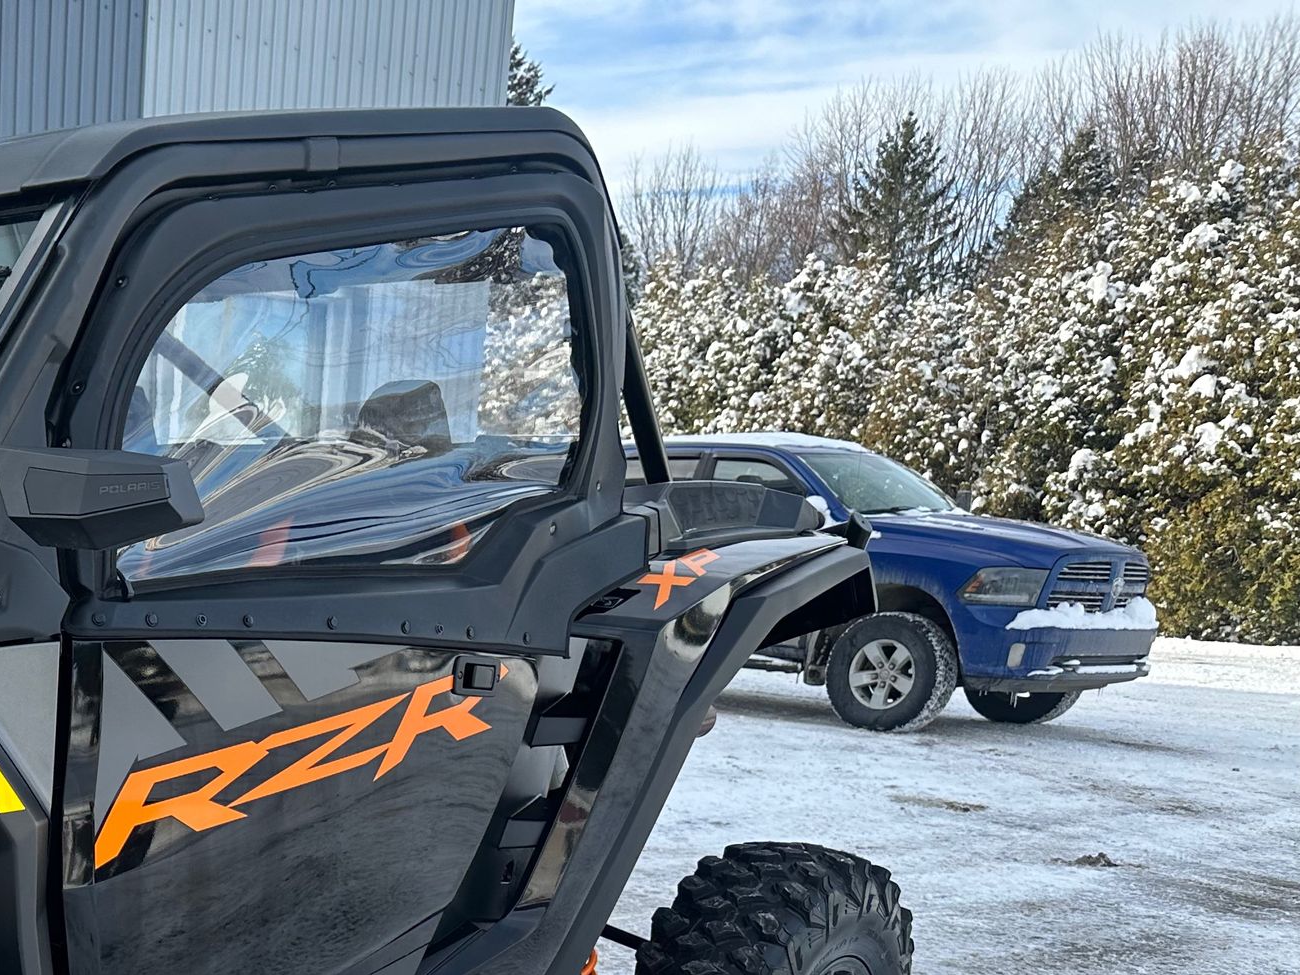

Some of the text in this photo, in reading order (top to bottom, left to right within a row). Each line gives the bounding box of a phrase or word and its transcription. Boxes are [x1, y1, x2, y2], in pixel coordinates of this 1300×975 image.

[99, 480, 161, 496] POLARIS
[636, 548, 721, 610] XP
[94, 663, 509, 870] RZR
